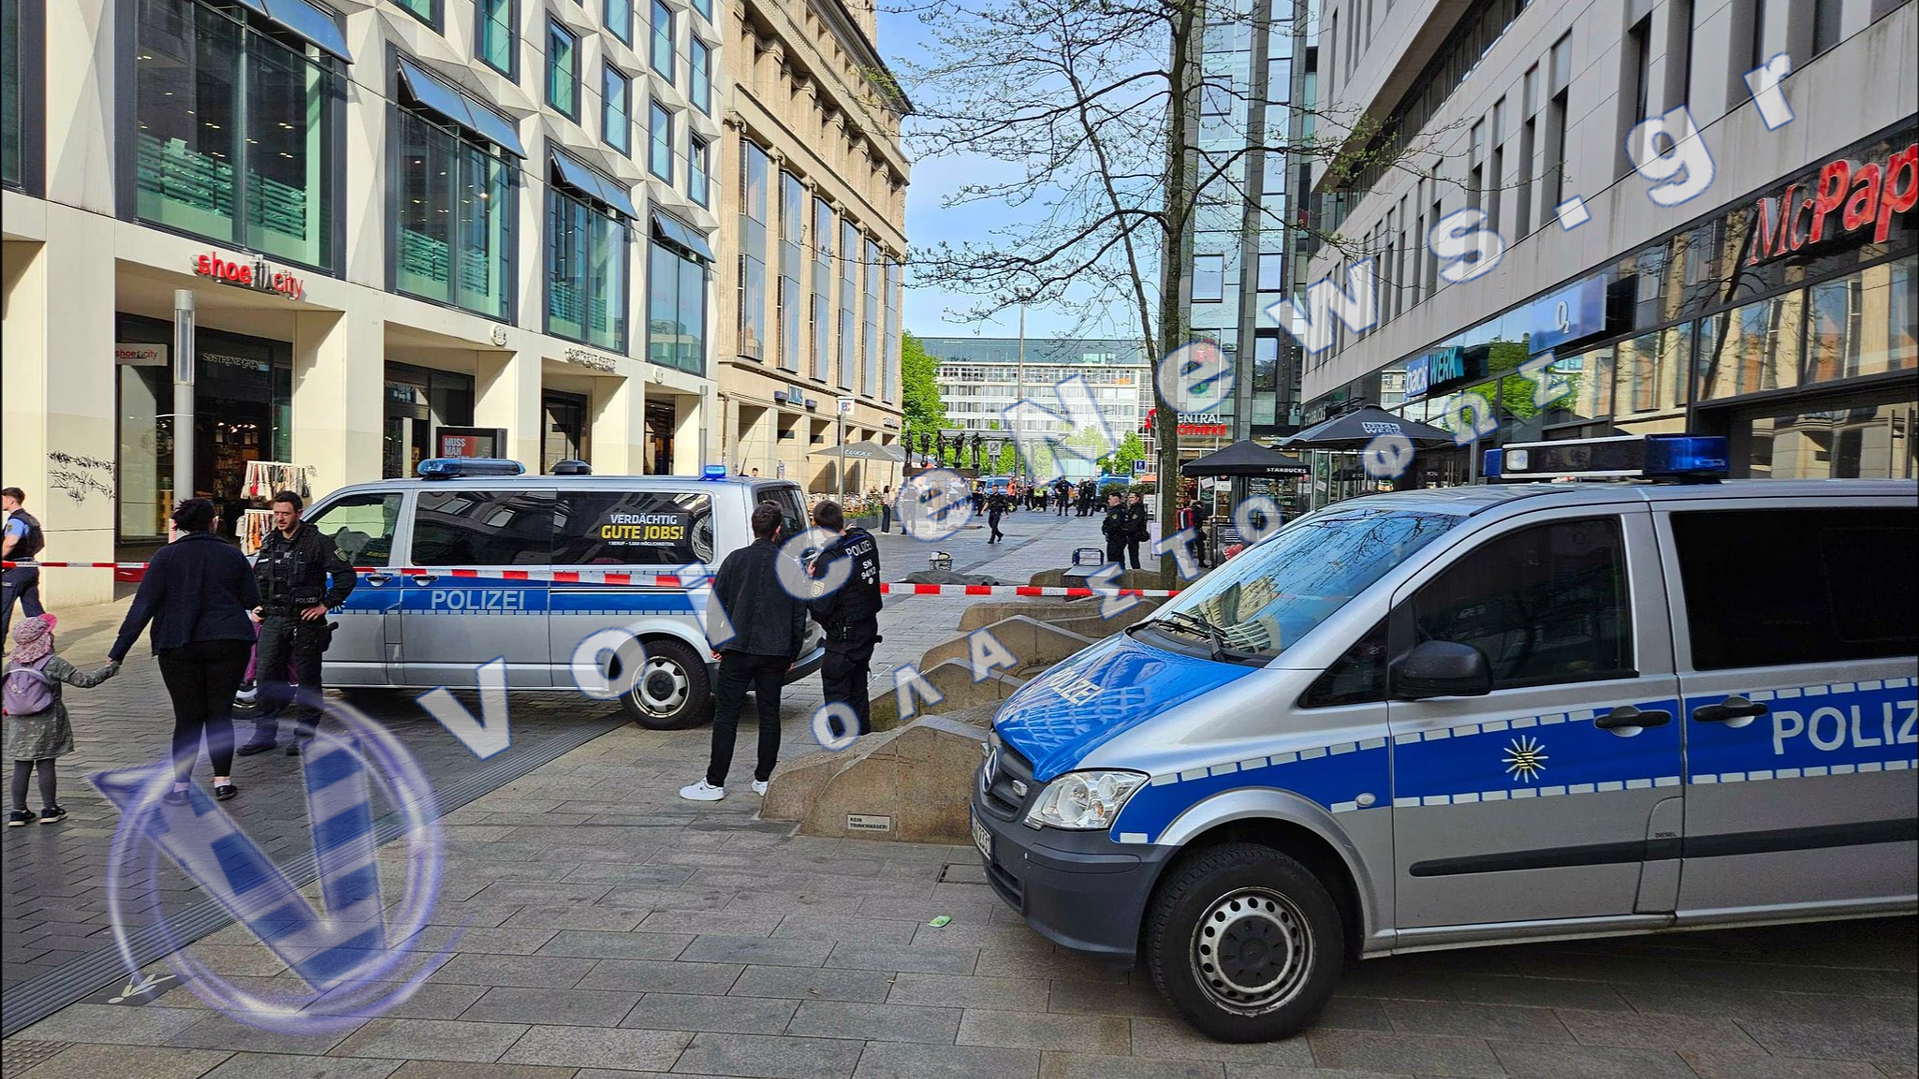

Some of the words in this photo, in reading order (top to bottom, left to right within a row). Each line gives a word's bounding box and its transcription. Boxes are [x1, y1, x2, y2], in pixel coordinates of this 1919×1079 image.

[197, 251, 253, 285] shoe
[274, 270, 304, 300] city
[115, 349, 136, 358] shoe
[1177, 413, 1223, 423] ENTRAL
[1177, 423, 1226, 436] OTHEKE
[444, 437, 466, 447] MUSS
[845, 449, 872, 458] LUKAS
[1266, 467, 1307, 475] STARBUCKS
[610, 512, 678, 525] VERDÄCHTIG
[601, 525, 640, 539] GUTE
[643, 526, 685, 540] JOBS!
[845, 540, 873, 559] POLIZEI
[862, 559, 873, 569] SN
[430, 589, 525, 610] POLIZEI
[1047, 667, 1105, 707] OLIZEI
[1772, 699, 1919, 755] POLIZ
